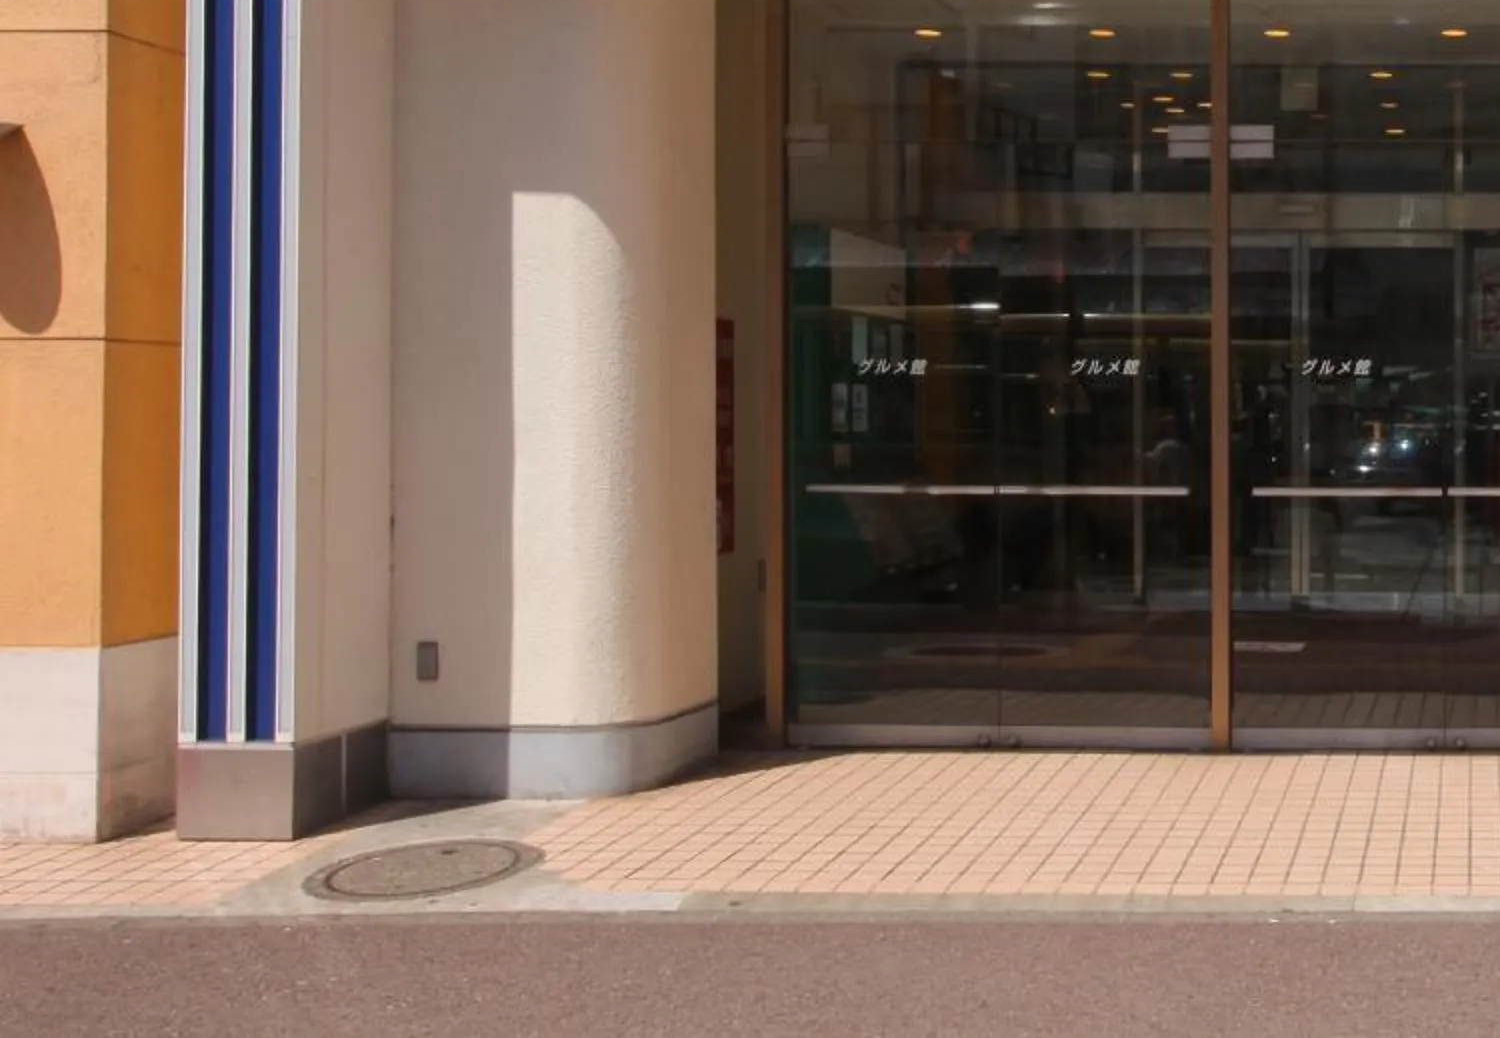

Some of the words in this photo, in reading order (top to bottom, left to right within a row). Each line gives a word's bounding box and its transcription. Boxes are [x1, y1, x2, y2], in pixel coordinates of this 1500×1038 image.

[859, 359, 928, 375] グルメ館
[1071, 359, 1141, 375] グルメ館
[1301, 359, 1372, 375] グルメ館
